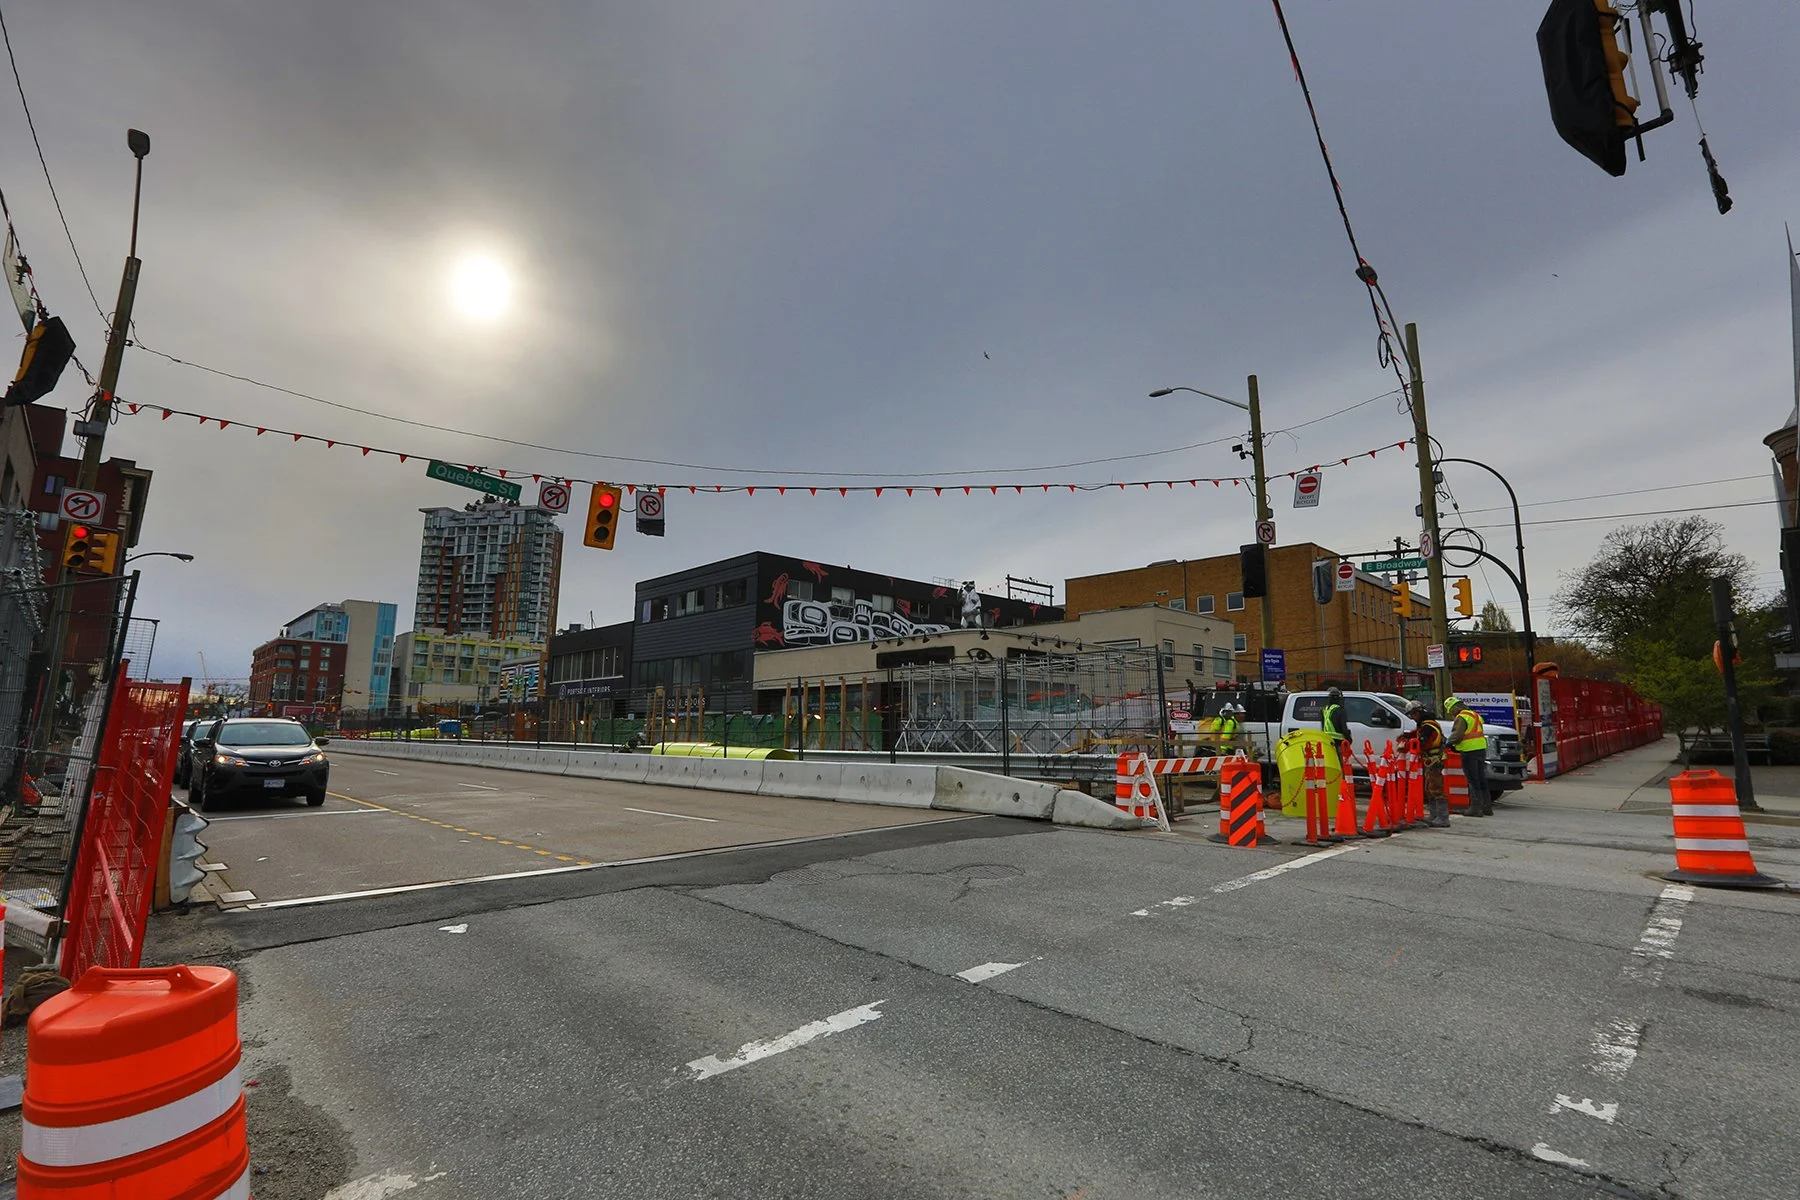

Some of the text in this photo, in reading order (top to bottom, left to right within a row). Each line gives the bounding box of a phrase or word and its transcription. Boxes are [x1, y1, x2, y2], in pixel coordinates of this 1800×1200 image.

[435, 465, 515, 496] Quebec St
[1366, 559, 1422, 571] E Broadway
